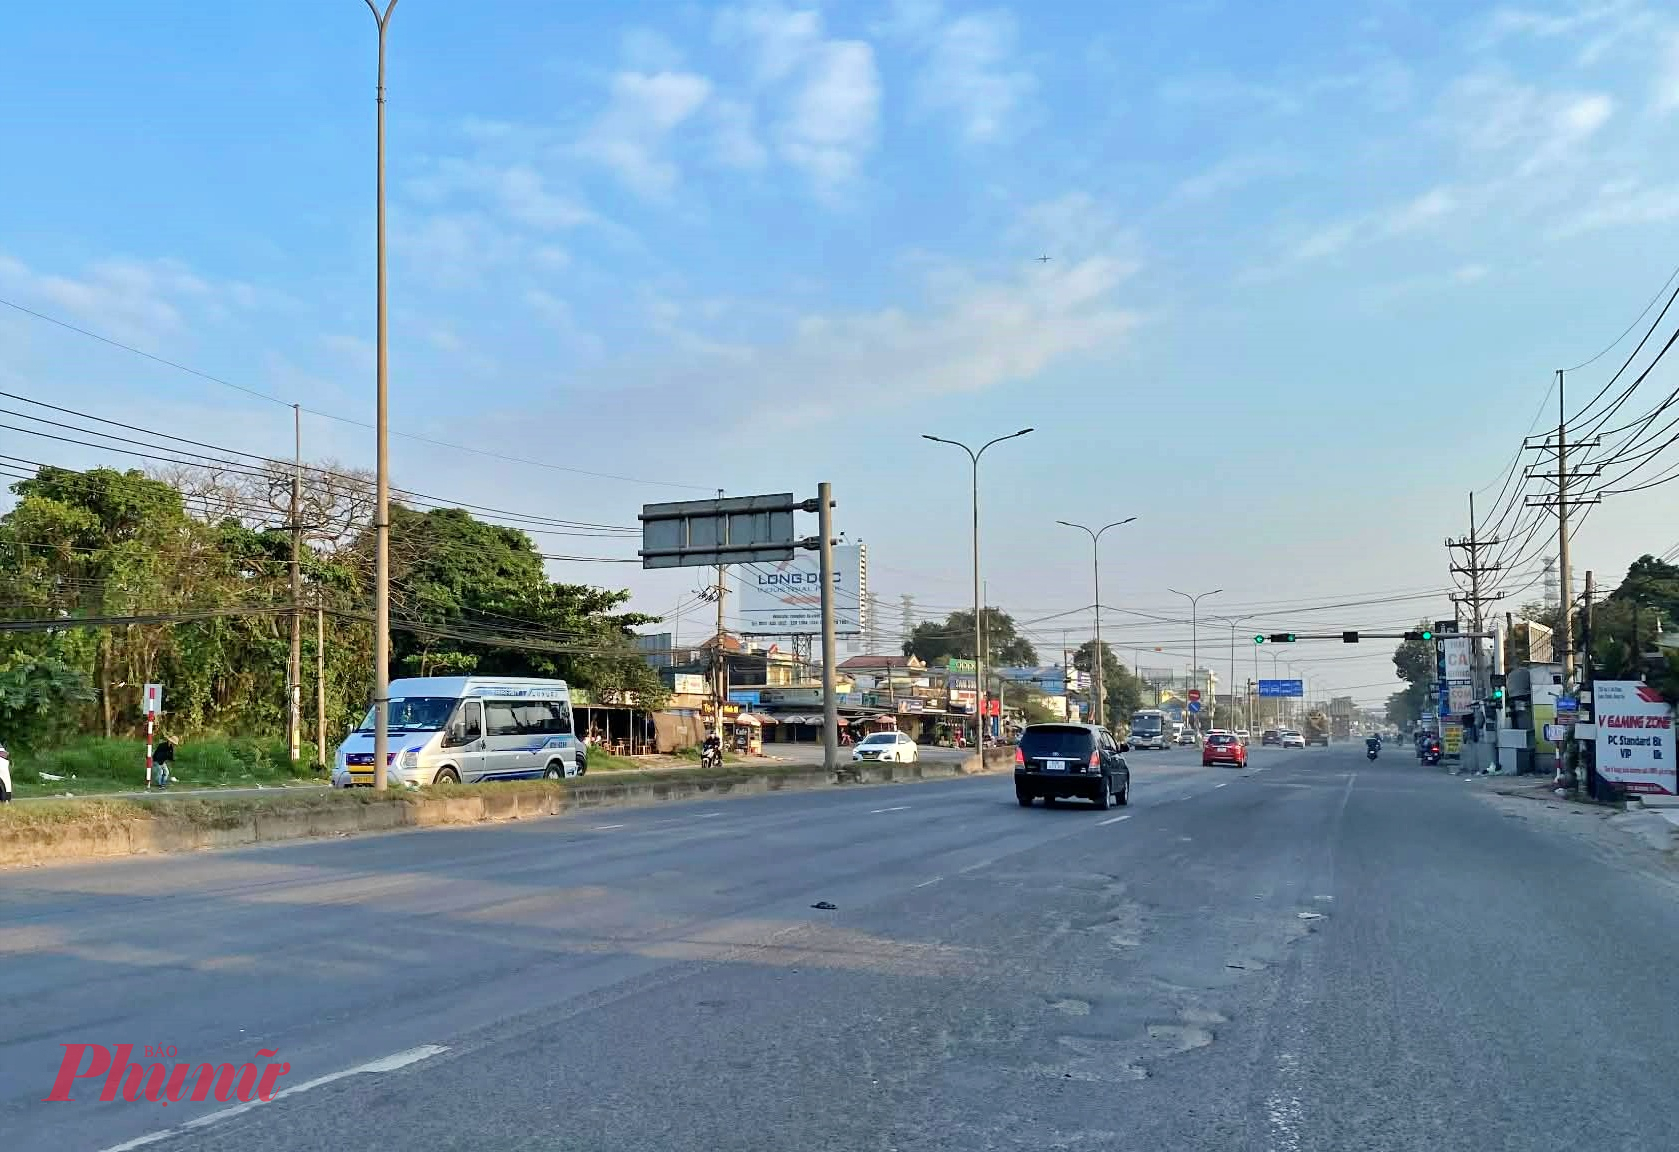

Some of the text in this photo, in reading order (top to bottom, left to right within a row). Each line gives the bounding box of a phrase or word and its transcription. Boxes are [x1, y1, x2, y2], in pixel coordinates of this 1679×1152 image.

[758, 572, 842, 585] LONG DC
[1599, 715, 1671, 729] V GAMING ZONE
[1608, 735, 1617, 745] PC
[1619, 736, 1650, 746] Standard
[1620, 748, 1631, 758] VIP
